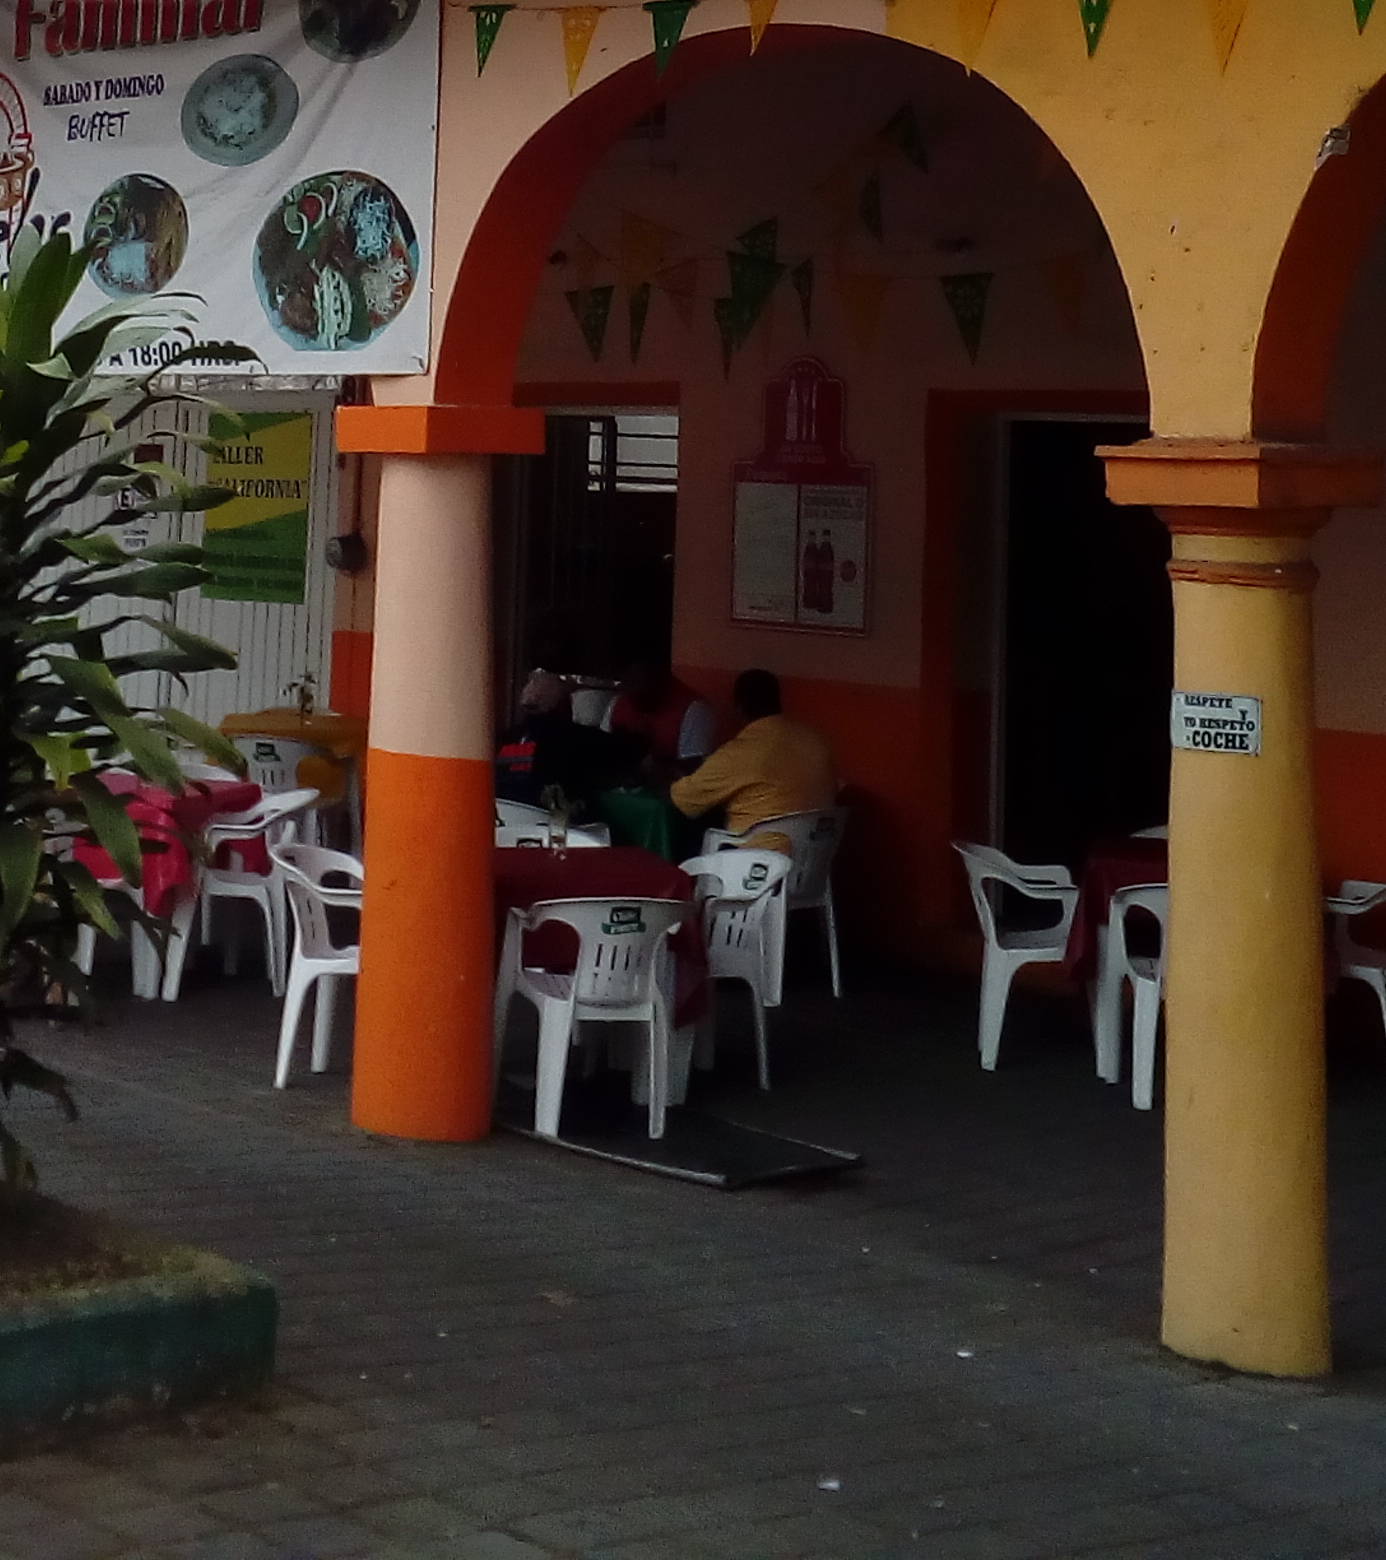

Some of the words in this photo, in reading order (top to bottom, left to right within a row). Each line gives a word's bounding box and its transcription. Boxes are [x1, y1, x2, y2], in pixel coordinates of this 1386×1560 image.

[43, 81, 90, 106] SABADO
[93, 80, 103, 101] Y
[105, 74, 165, 99] DOMINGO
[67, 111, 131, 142] BUFFET
[1198, 718, 1255, 732] RESPETO
[1192, 730, 1250, 750] COCHE
